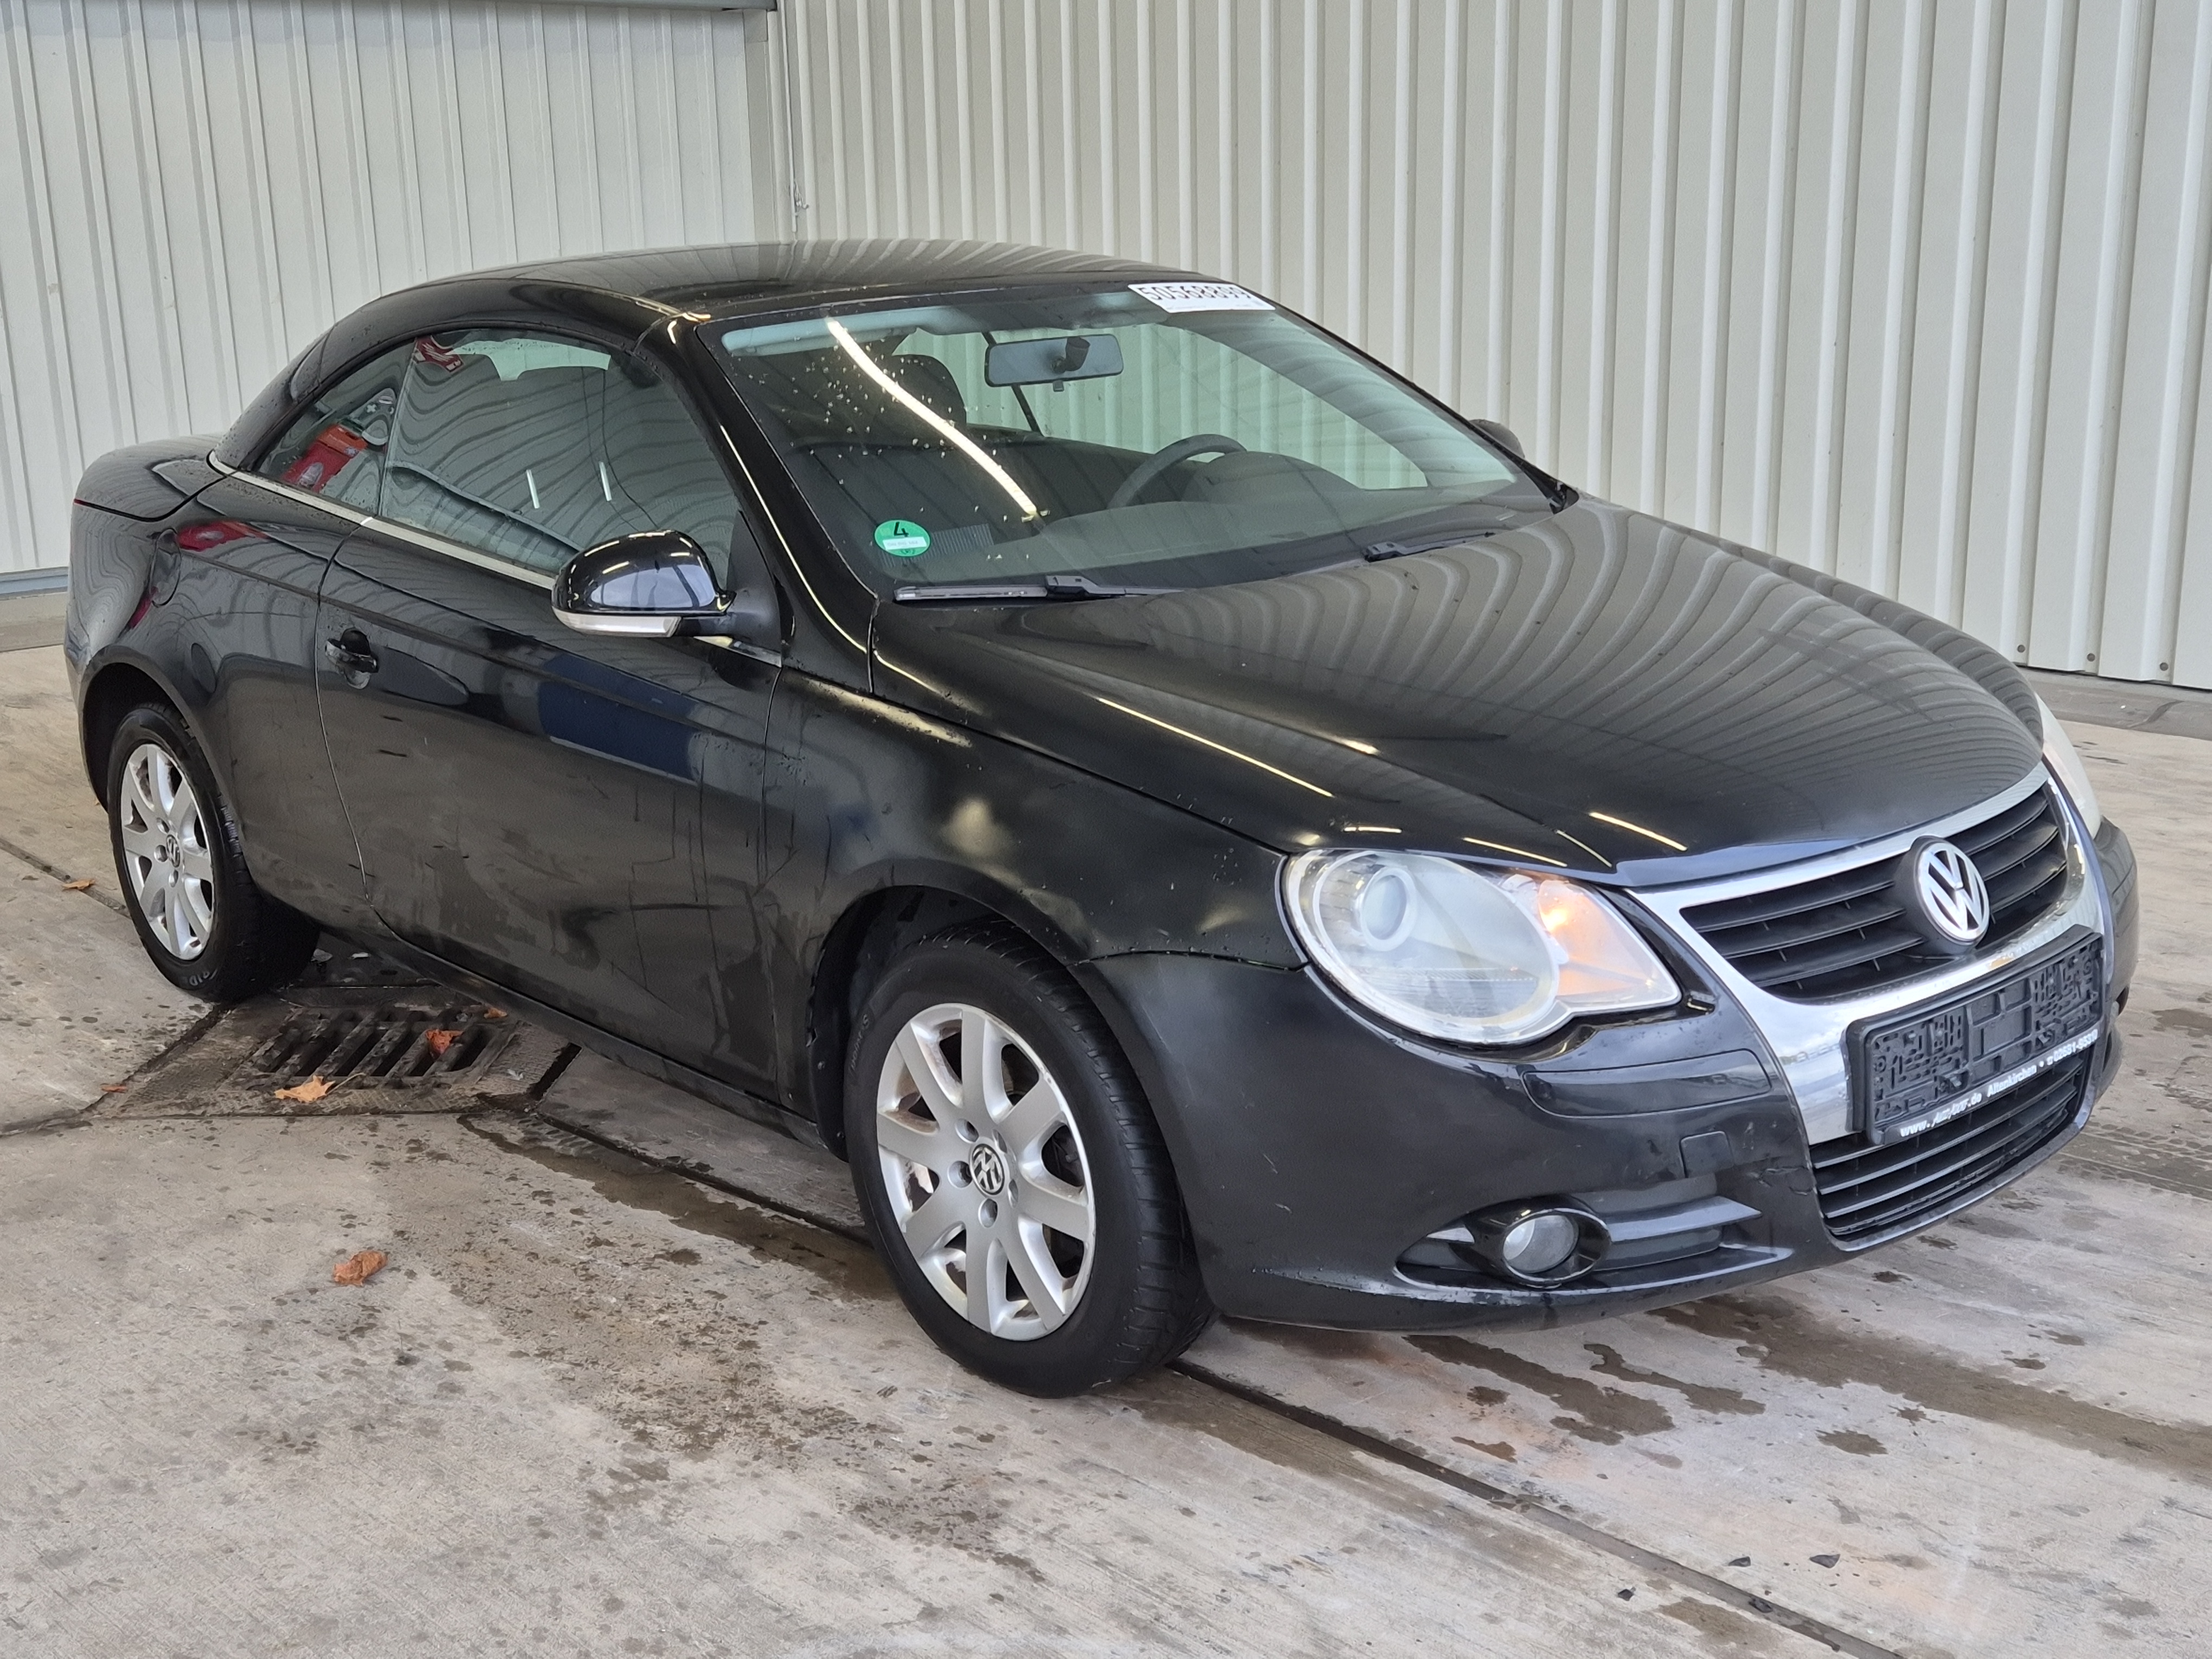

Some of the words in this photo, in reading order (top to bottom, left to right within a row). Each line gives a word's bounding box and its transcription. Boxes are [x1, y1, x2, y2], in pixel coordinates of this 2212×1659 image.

[1137, 286, 1250, 300] 50568899
[893, 522, 909, 537] 4
[1918, 843, 1989, 940] VW
[972, 1143, 1005, 1195] VW
